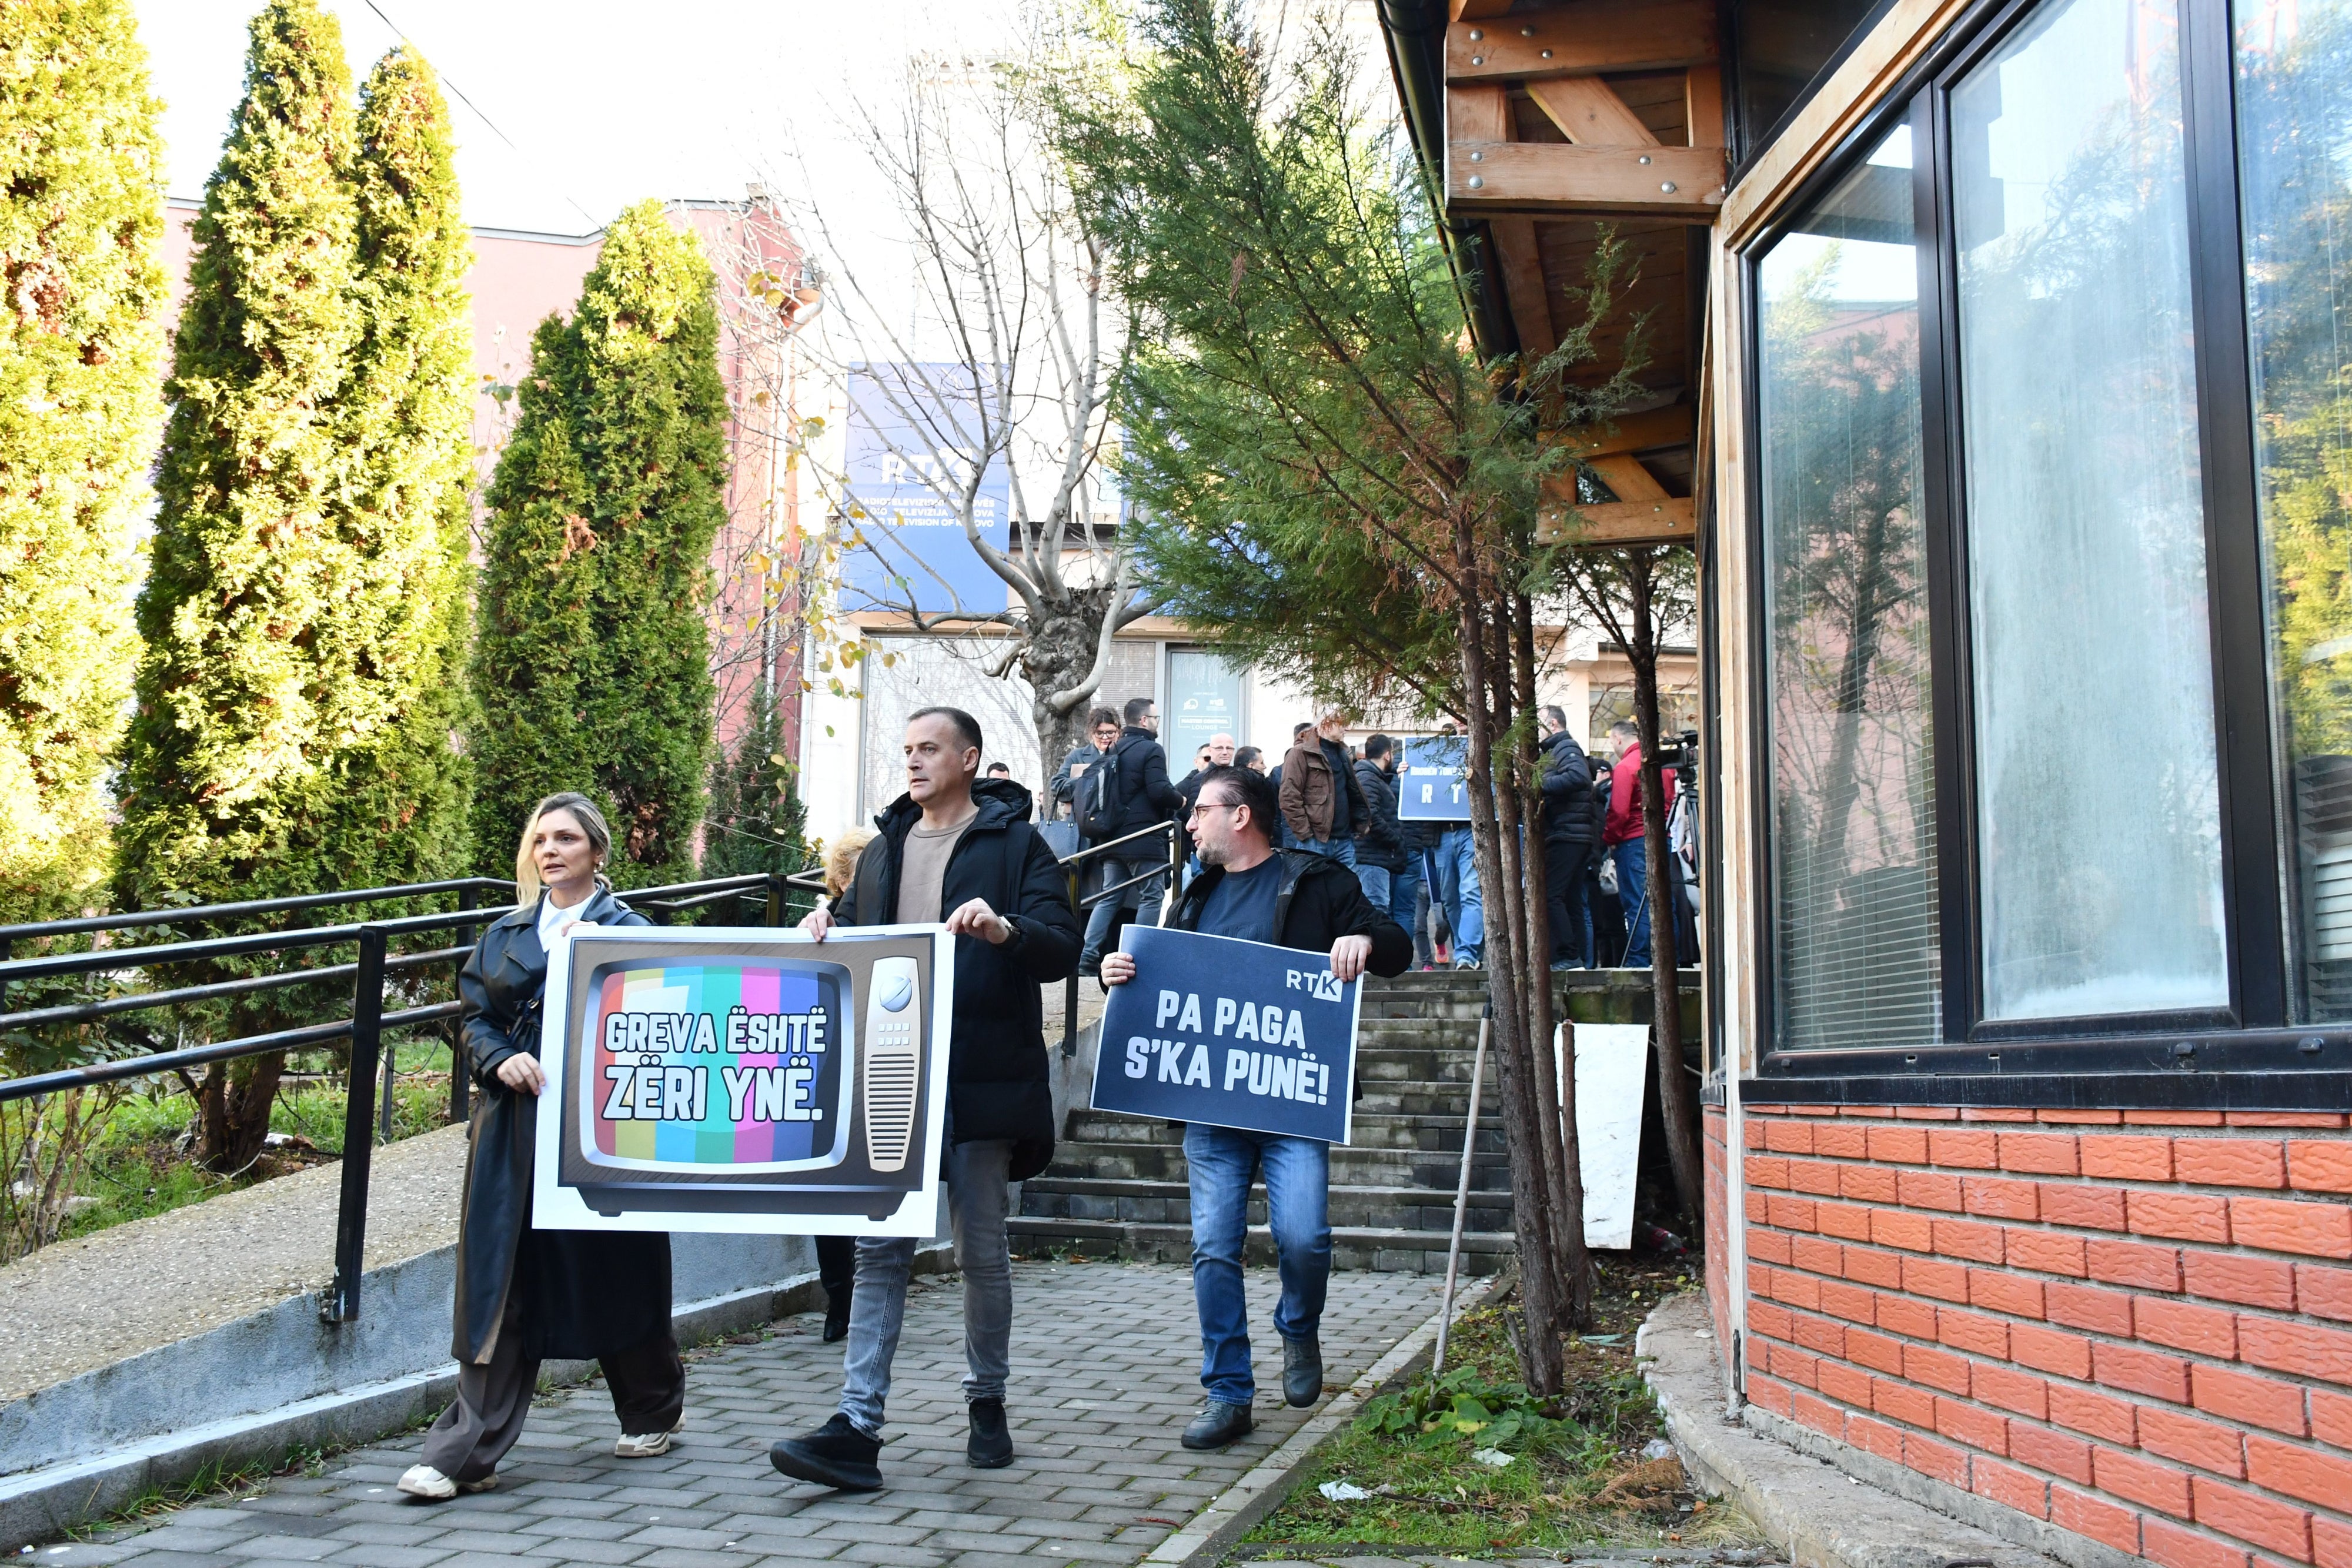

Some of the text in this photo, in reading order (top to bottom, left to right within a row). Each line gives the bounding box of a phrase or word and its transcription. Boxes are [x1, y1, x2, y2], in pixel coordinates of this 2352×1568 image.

[882, 450, 969, 489] RTK
[887, 517, 940, 527] TEEVISION
[941, 519, 954, 527] OF
[956, 519, 994, 527] KOVO
[1286, 969, 1340, 998] RTK
[604, 1006, 827, 1054] GREVA ËSHTË
[1155, 989, 1305, 1049] PA PAGA
[602, 1054, 823, 1122] ZËRI YNË.
[1124, 1037, 1329, 1106] S'KA PUNË!
